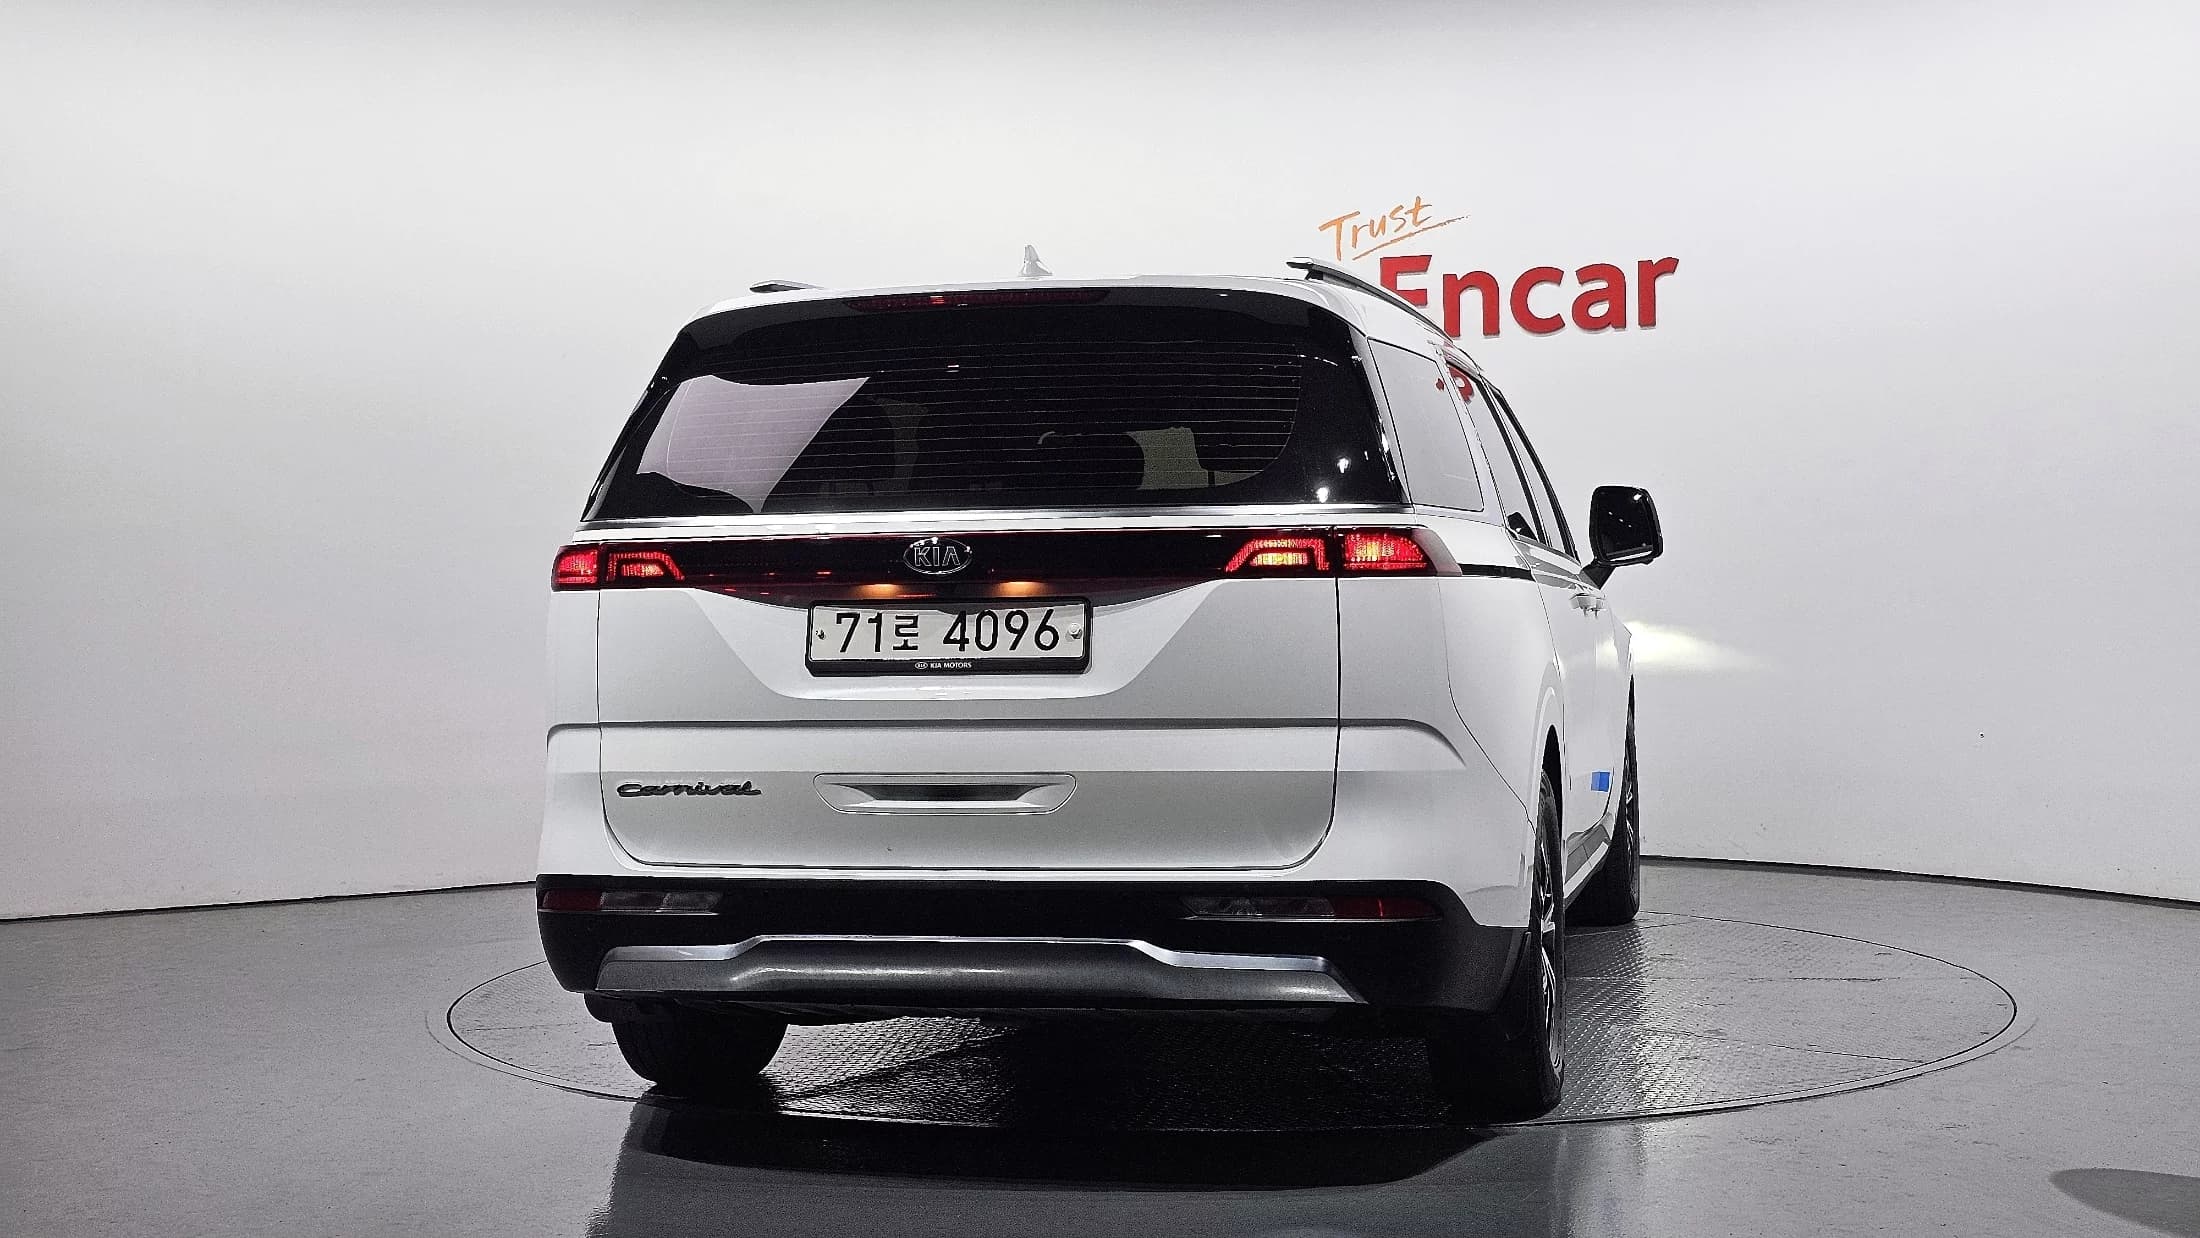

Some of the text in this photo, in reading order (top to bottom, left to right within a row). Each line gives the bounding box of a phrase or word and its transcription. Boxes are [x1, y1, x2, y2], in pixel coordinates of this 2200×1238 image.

[1319, 196, 1433, 261] Trust
[914, 546, 960, 567] KIA
[836, 609, 1060, 653] 71로 4096
[617, 781, 762, 797] Carnival
